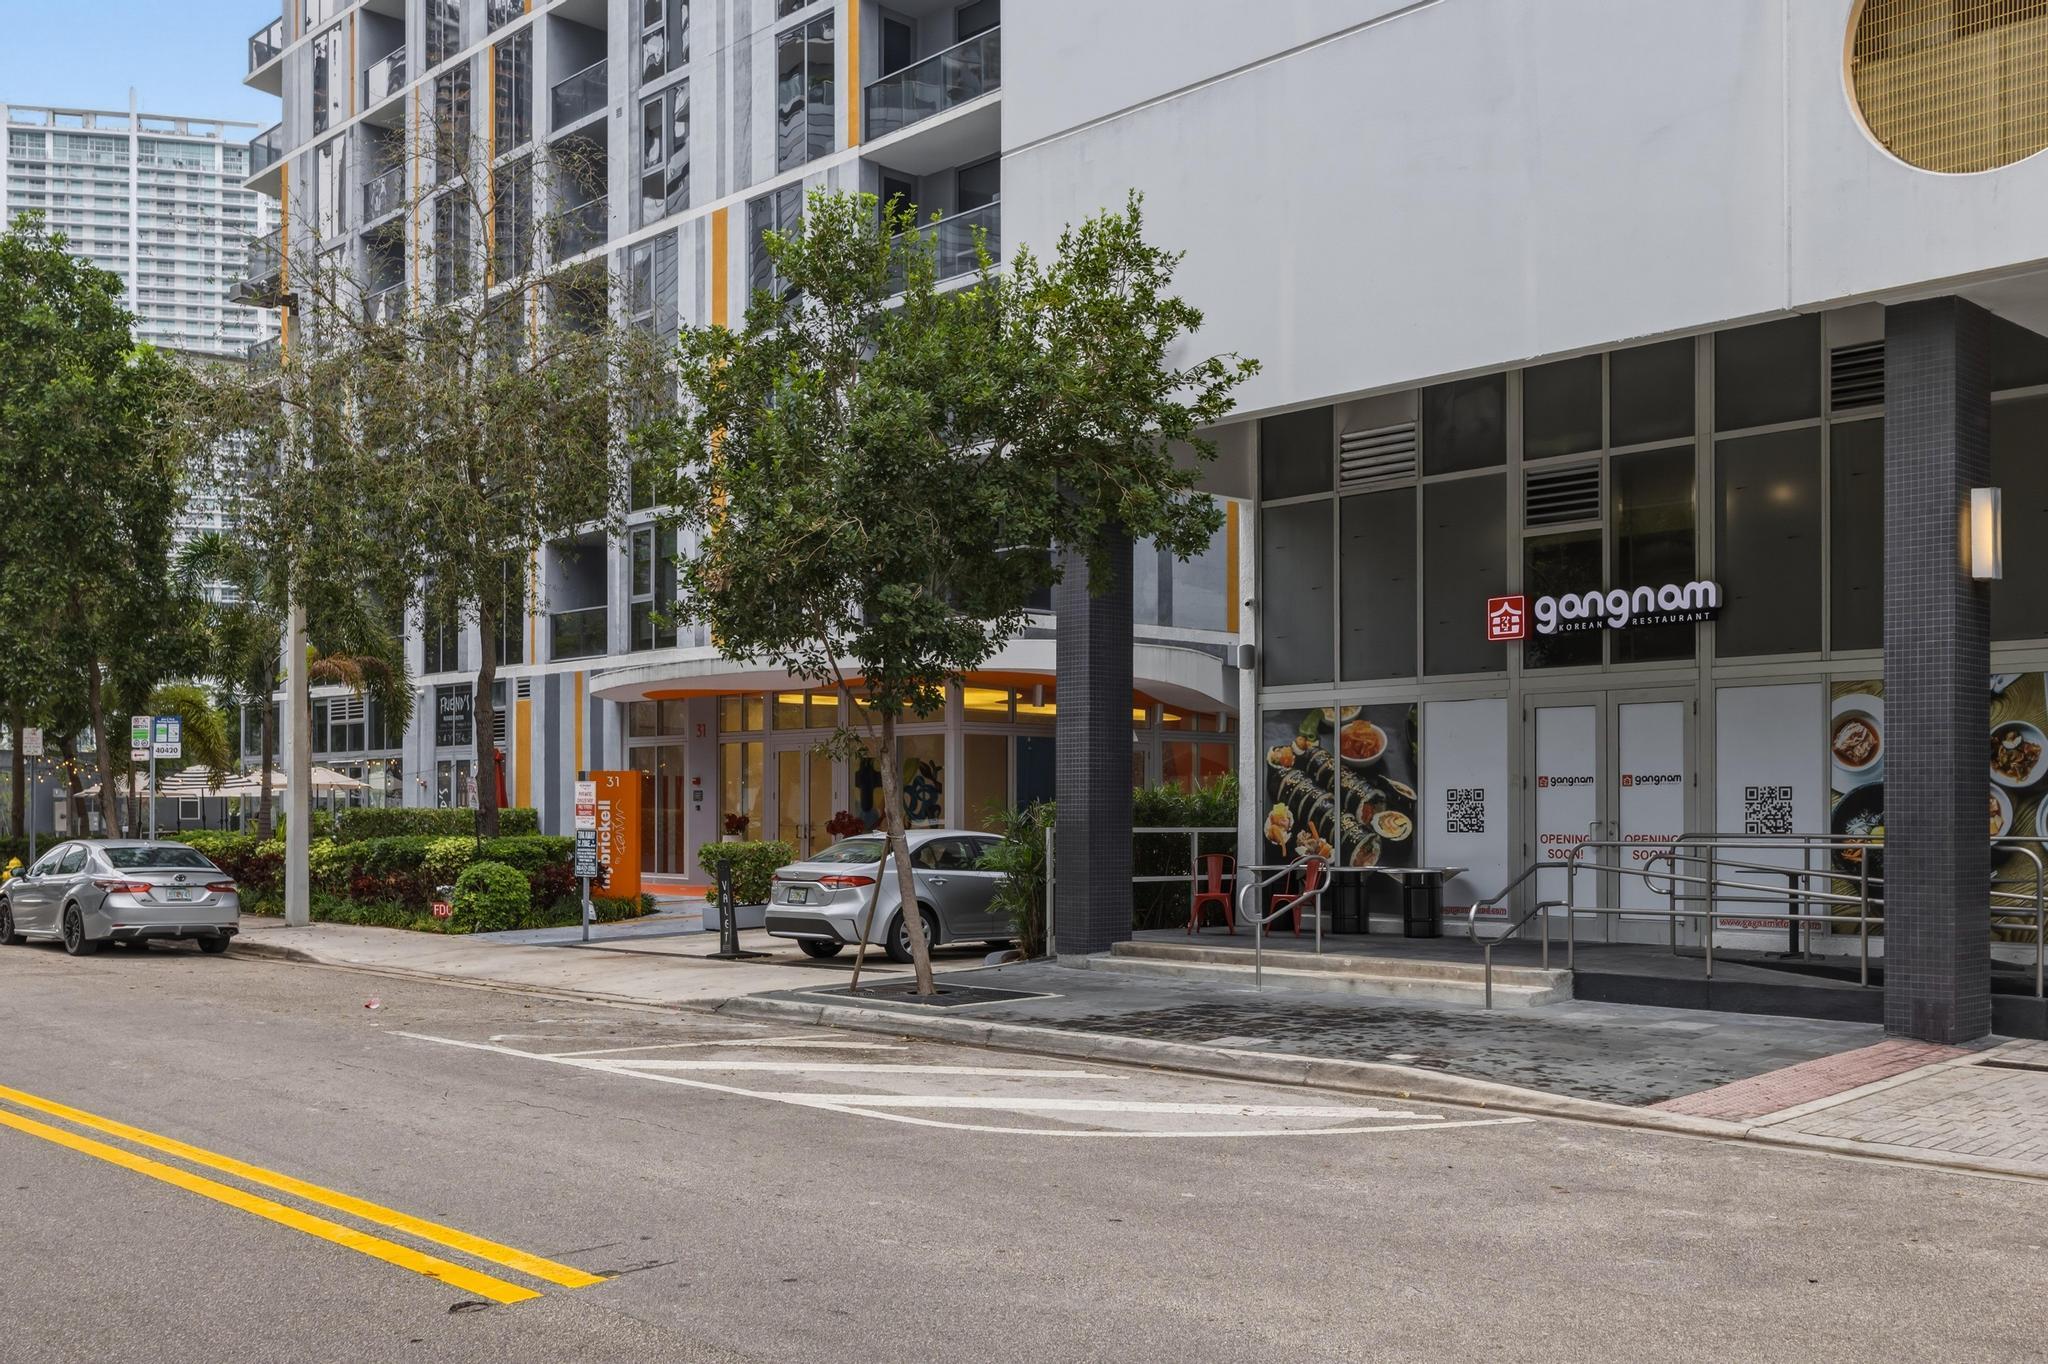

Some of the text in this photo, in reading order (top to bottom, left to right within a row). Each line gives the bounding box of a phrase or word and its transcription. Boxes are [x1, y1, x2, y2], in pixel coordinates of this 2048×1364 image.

[1534, 580, 1717, 635] gangnam
[1558, 612, 1710, 632] KOREAN RESTAURANT
[696, 723, 706, 738] 31
[606, 776, 620, 788] 31
[1550, 776, 1594, 787] gangnam
[1635, 774, 1682, 786] gangnam
[1540, 833, 1591, 844] OPENING
[721, 880, 731, 942] VALET
